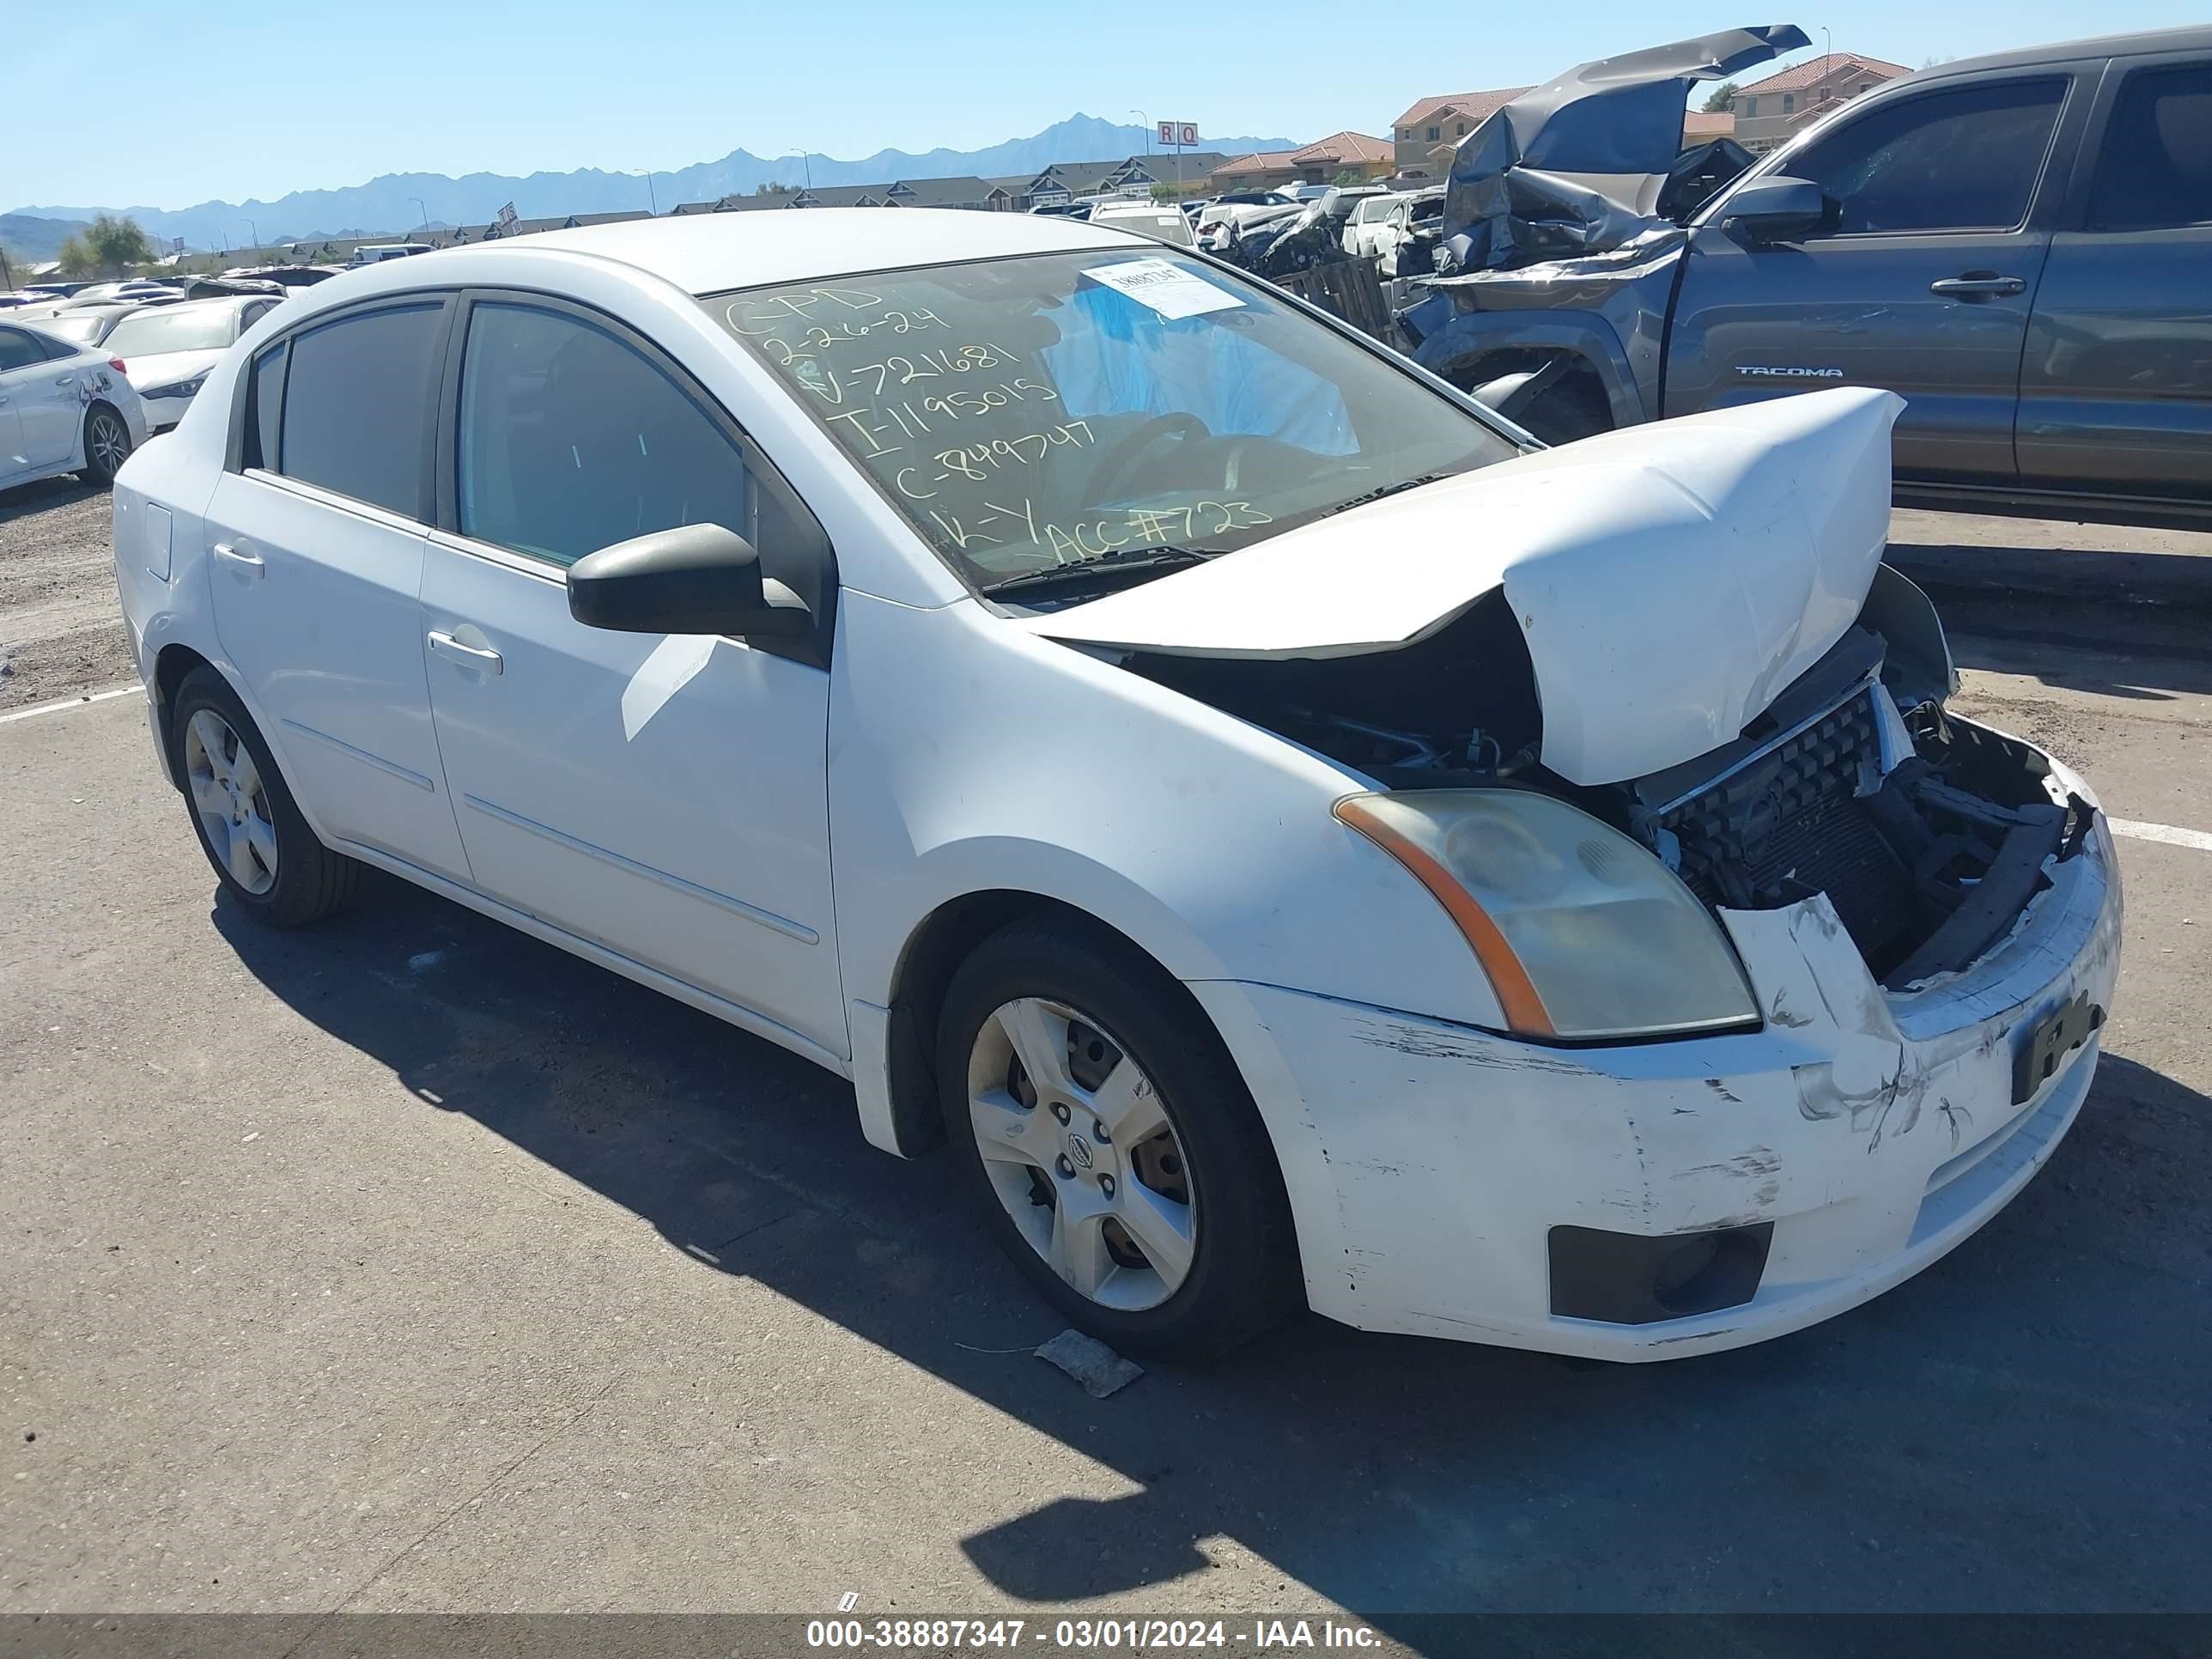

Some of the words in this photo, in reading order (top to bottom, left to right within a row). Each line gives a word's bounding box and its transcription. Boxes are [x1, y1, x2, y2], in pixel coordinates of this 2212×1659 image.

[1161, 125, 1172, 142] R
[1183, 126, 1196, 143] Q
[763, 307, 951, 365] 2-26-24
[1735, 367, 1844, 377] TACOMA
[896, 421, 1095, 499] C-849747
